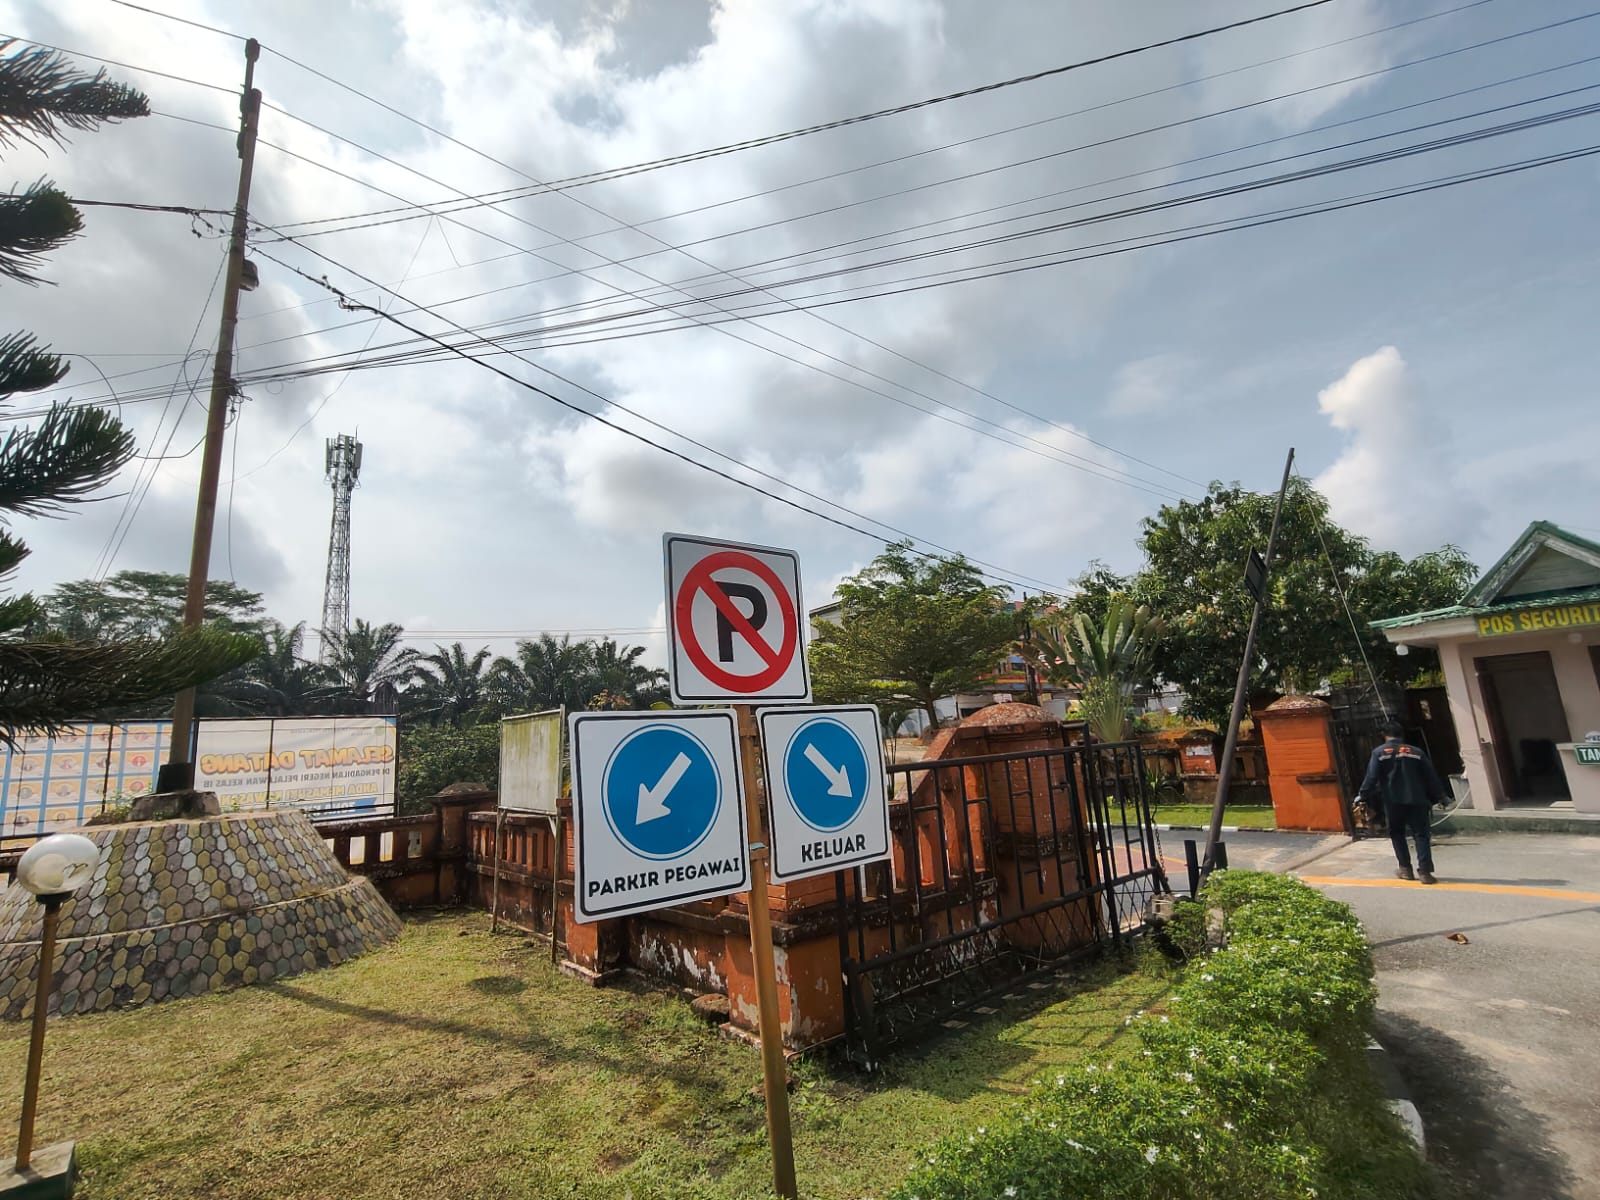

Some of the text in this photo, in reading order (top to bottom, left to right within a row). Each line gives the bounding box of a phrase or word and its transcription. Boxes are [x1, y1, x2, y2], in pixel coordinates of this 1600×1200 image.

[716, 581, 768, 663] P
[1478, 614, 1515, 635] POS
[801, 834, 866, 863] KELUAR
[588, 857, 740, 898] PARKIR PEGAWAI
